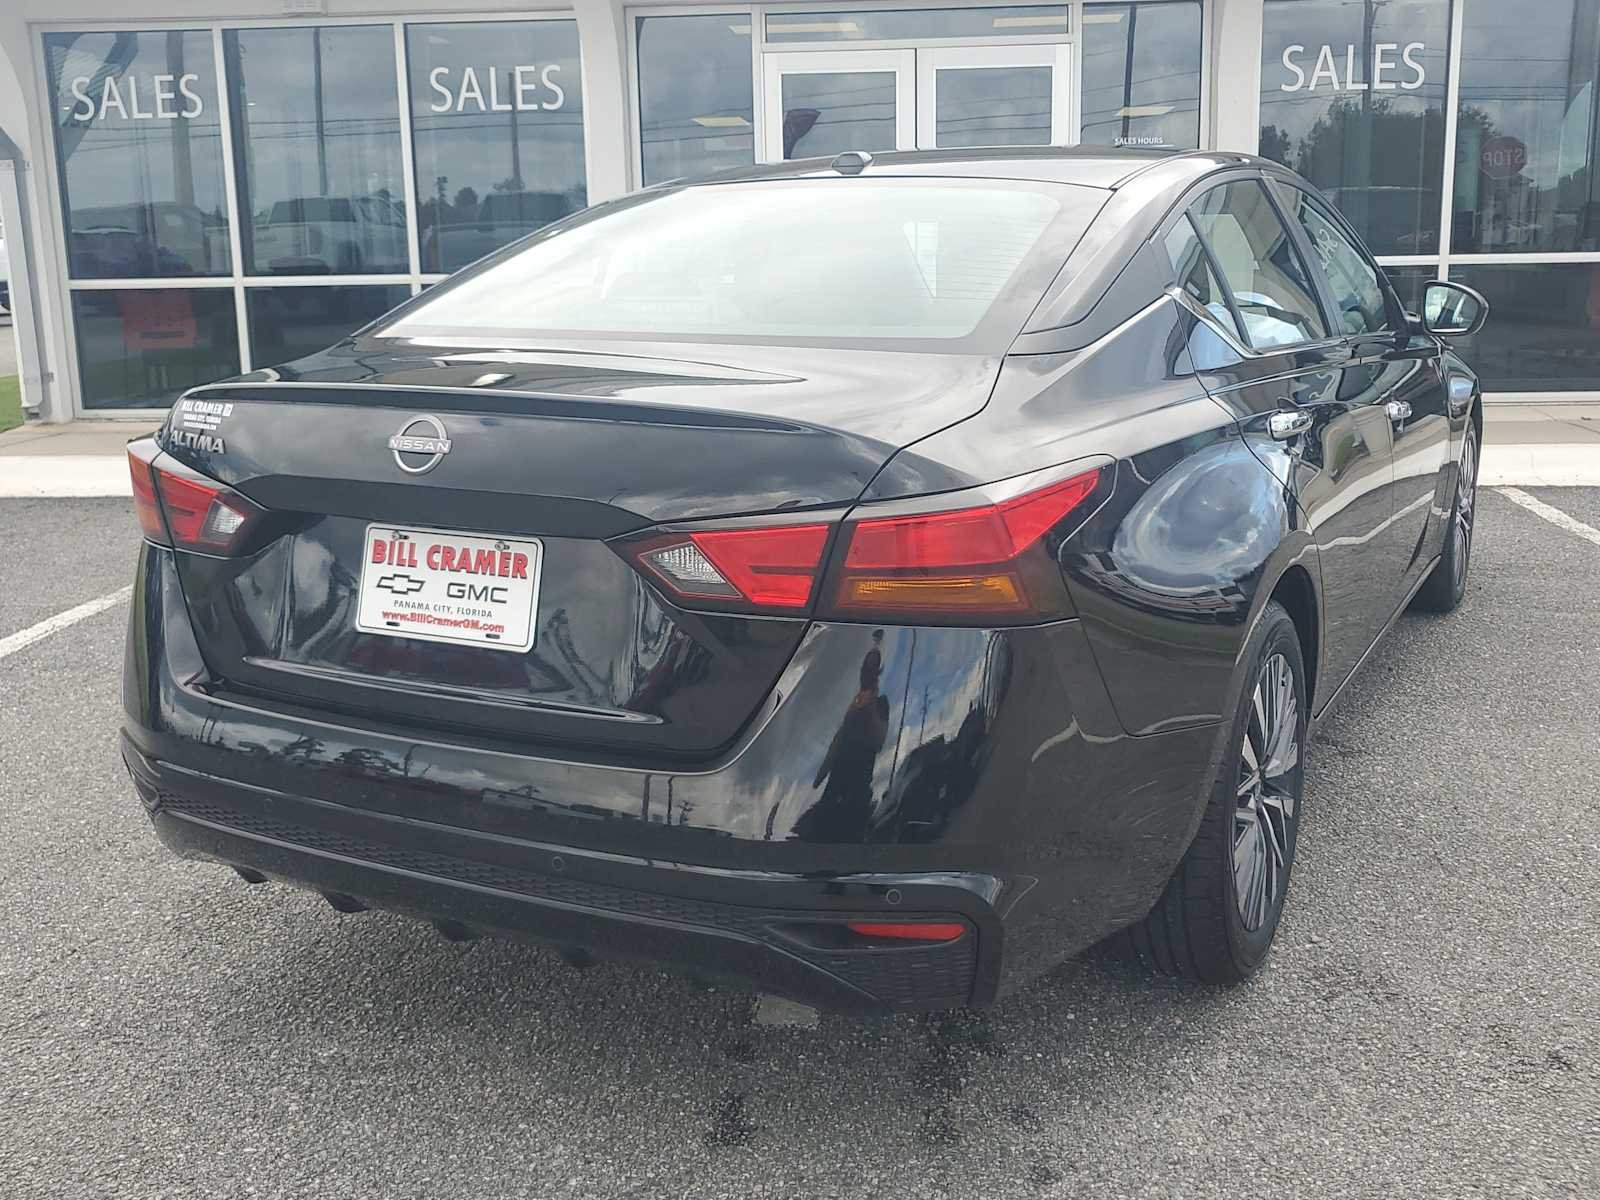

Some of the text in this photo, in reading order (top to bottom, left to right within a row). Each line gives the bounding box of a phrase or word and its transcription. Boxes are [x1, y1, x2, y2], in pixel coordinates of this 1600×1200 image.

[1281, 42, 1425, 92] SALES
[71, 73, 203, 121] SALES
[429, 64, 565, 112] SALES
[1114, 136, 1164, 146] SALES HOURS
[194, 401, 224, 415] CRAMER
[170, 430, 225, 454] ALTIMA
[390, 438, 449, 452] NISSAN
[372, 539, 529, 579] BILL CRAMER
[446, 582, 508, 604] GMC
[393, 600, 493, 618] PANAMA CITY, FLORIDA
[382, 610, 505, 633] www.BillCramerGM.com
